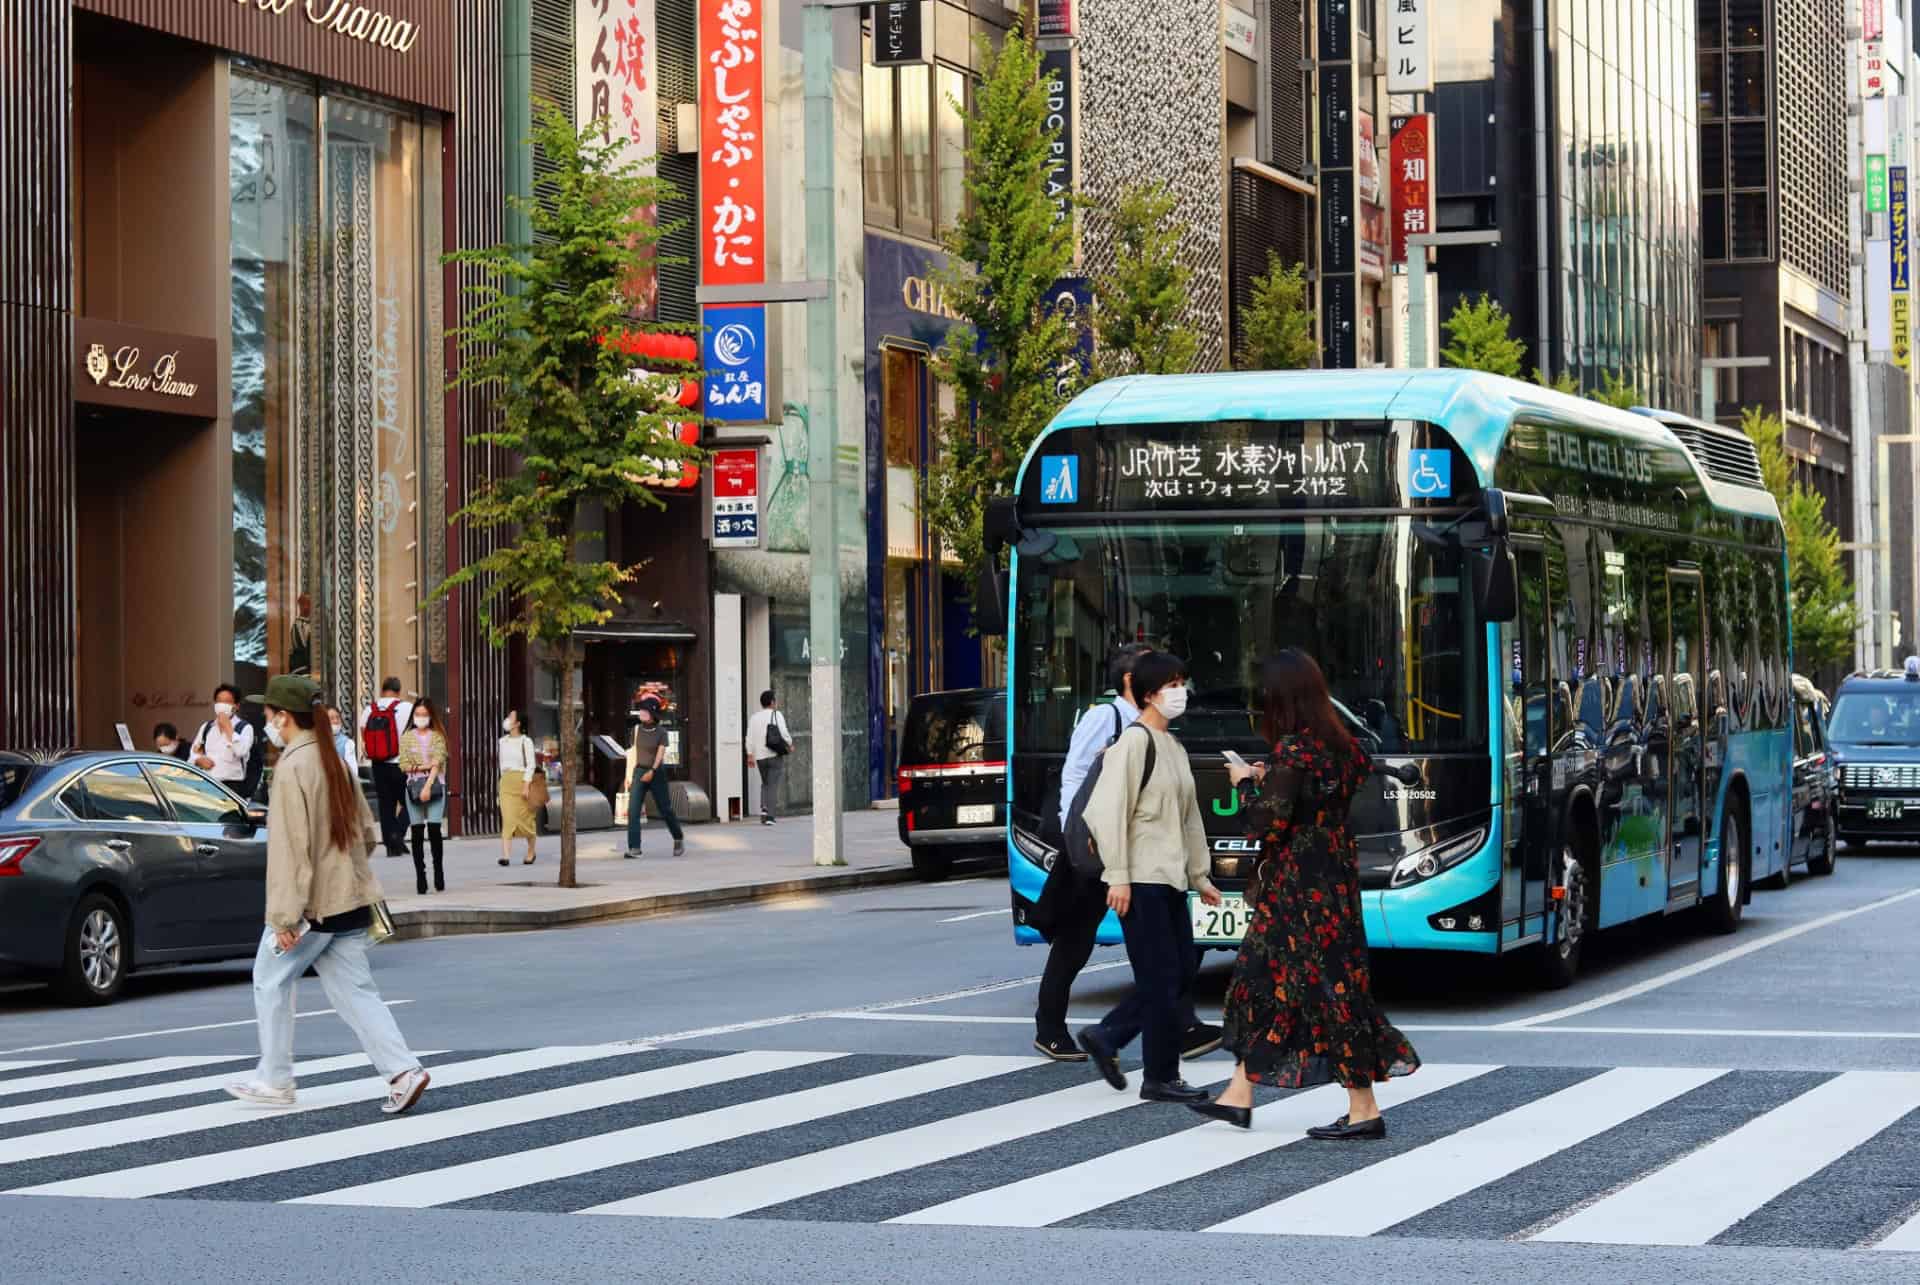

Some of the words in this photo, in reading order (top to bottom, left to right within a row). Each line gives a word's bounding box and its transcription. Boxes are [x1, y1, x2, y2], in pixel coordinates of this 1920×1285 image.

[306, 0, 420, 53] iana
[612, 0, 647, 145] 焼なら
[1047, 80, 1064, 130] BDC
[1048, 142, 1065, 233] PILATE
[1403, 159, 1425, 256] 知足常
[108, 345, 152, 392] Loro
[152, 350, 198, 397] Piana
[709, 381, 762, 406] らん月
[1121, 446, 1203, 477] JR竹芝
[1216, 442, 1370, 476] 水素シャトルバス
[1546, 430, 1588, 470] FUEL
[1588, 440, 1624, 478] CELL
[1624, 448, 1653, 484] BUS
[716, 519, 756, 534] 酒の穴
